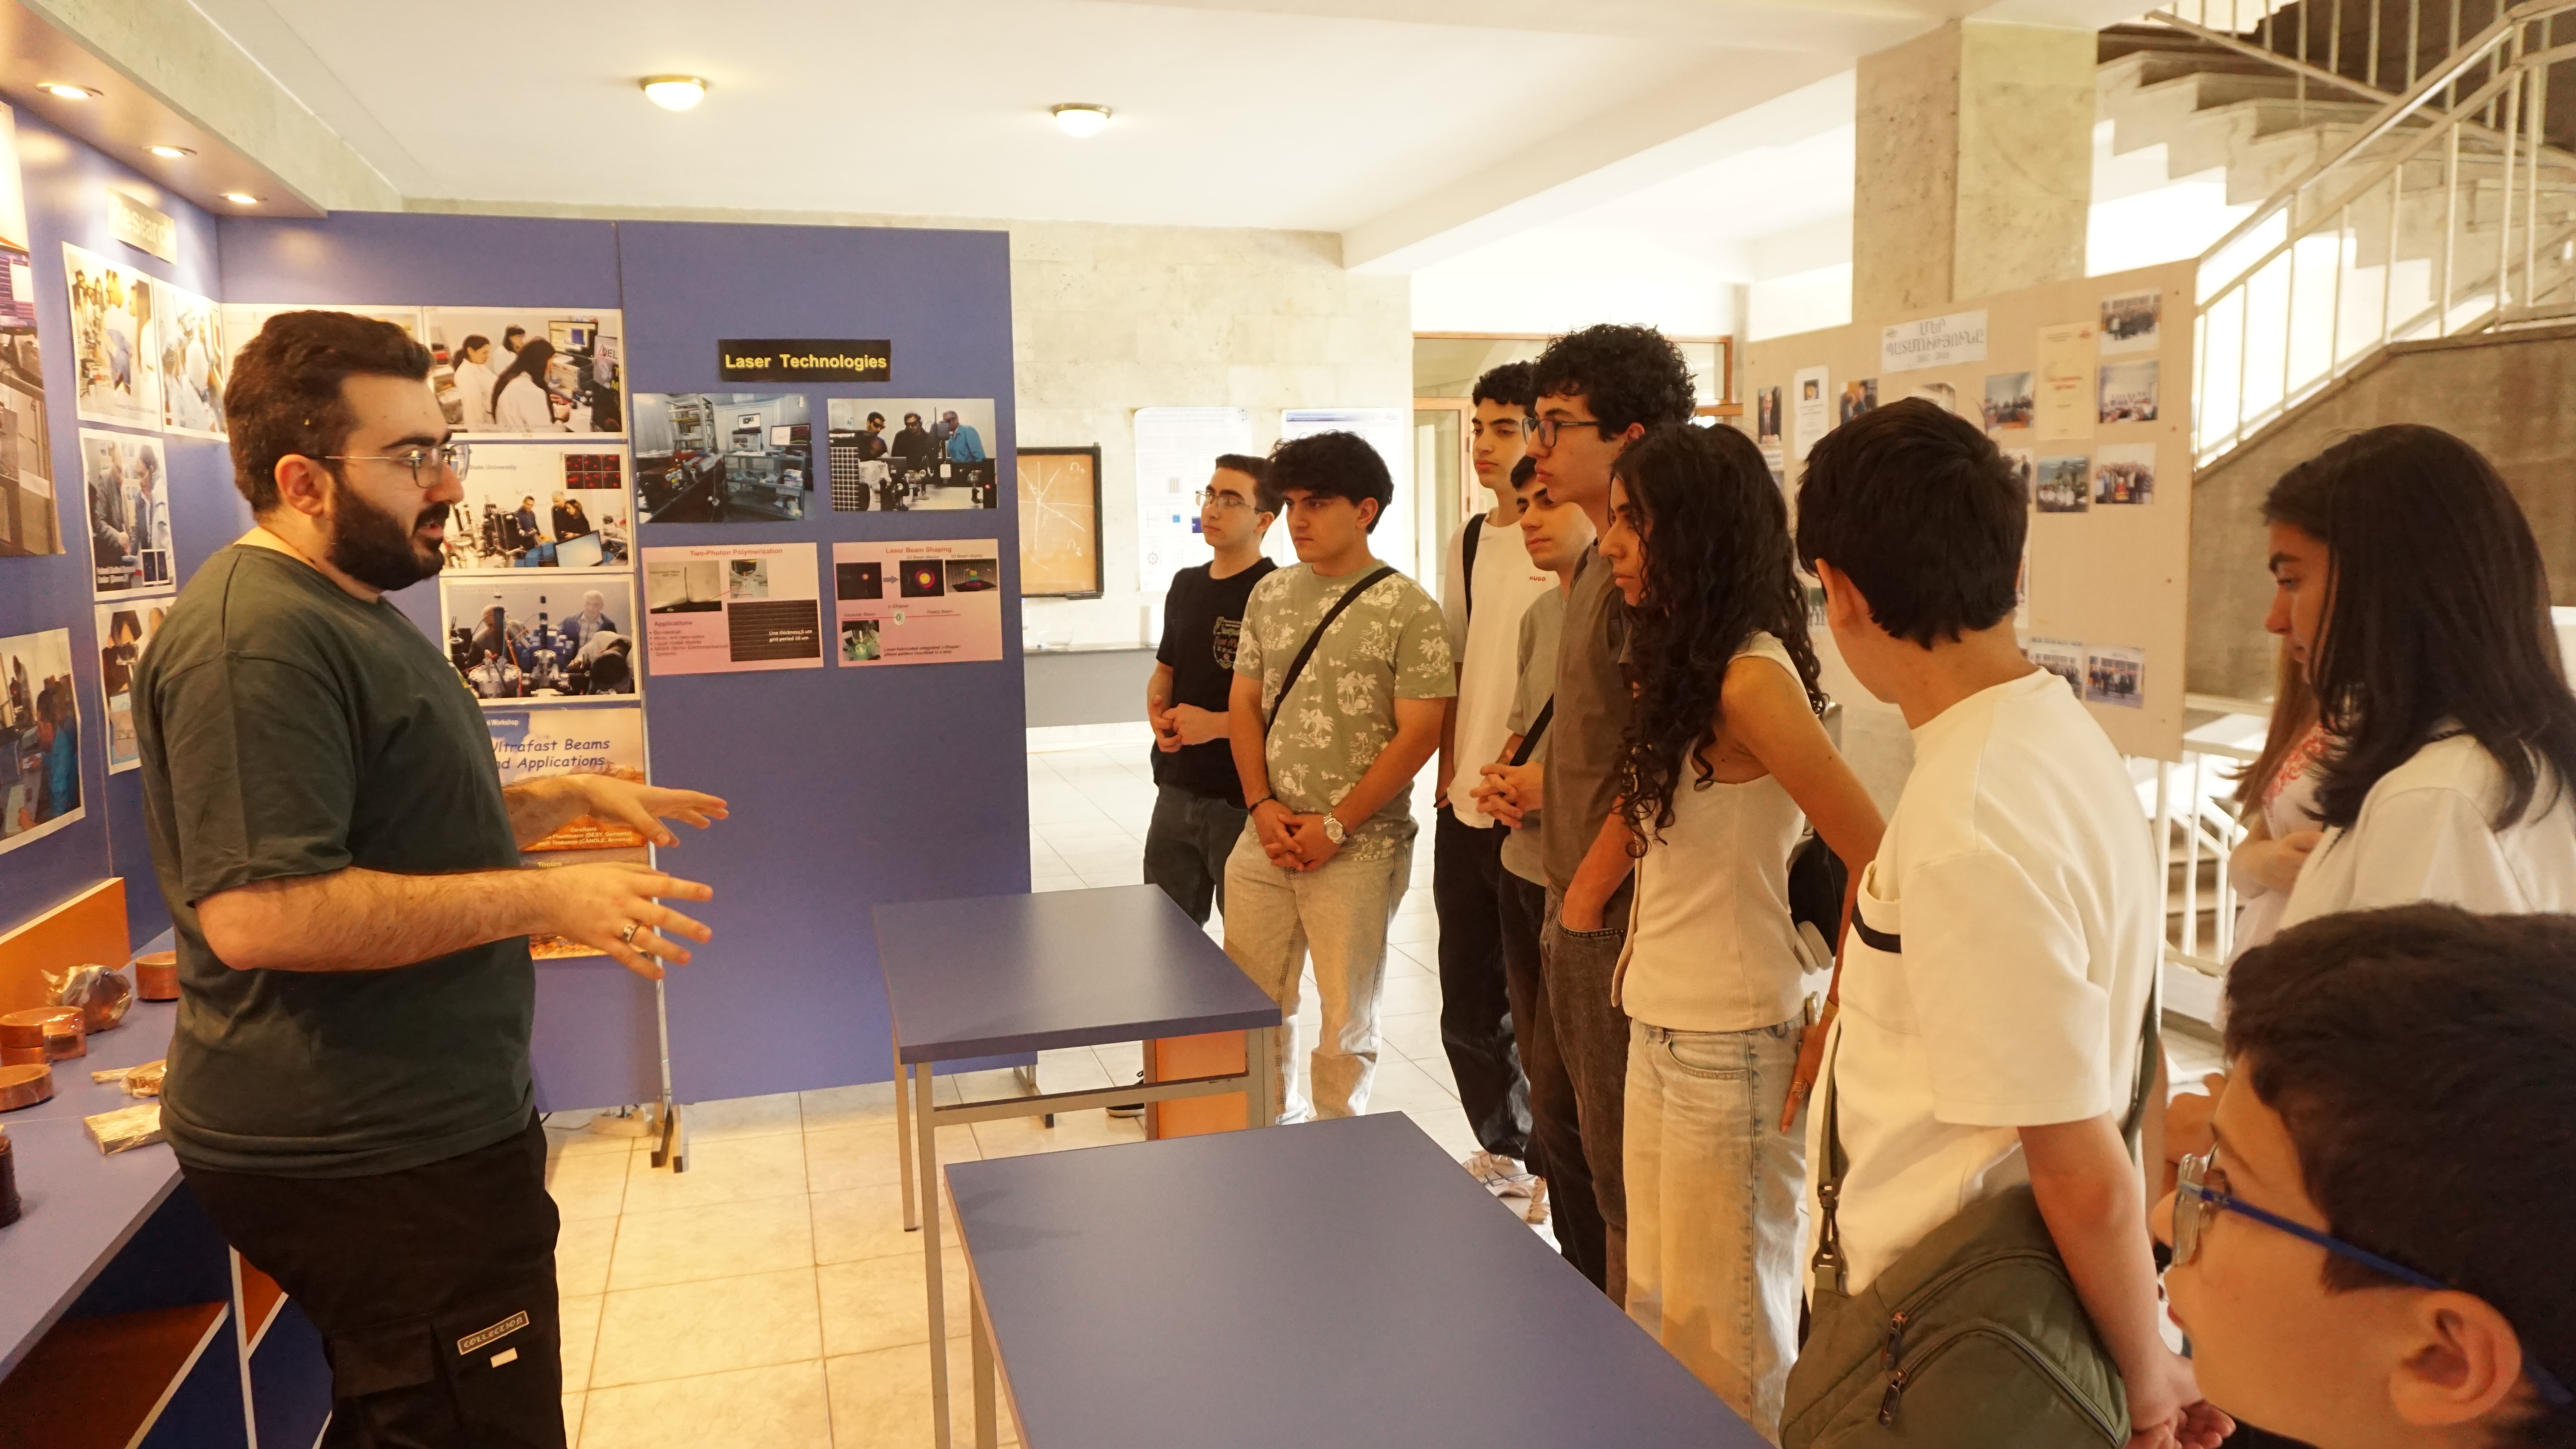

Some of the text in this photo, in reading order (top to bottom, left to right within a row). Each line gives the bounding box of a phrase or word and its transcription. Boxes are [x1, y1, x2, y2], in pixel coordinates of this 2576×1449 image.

[725, 353, 887, 371] Laser Technologies
[565, 738, 610, 750] Beams
[517, 755, 605, 771] Applications
[464, 1317, 523, 1348] COLLECTION
